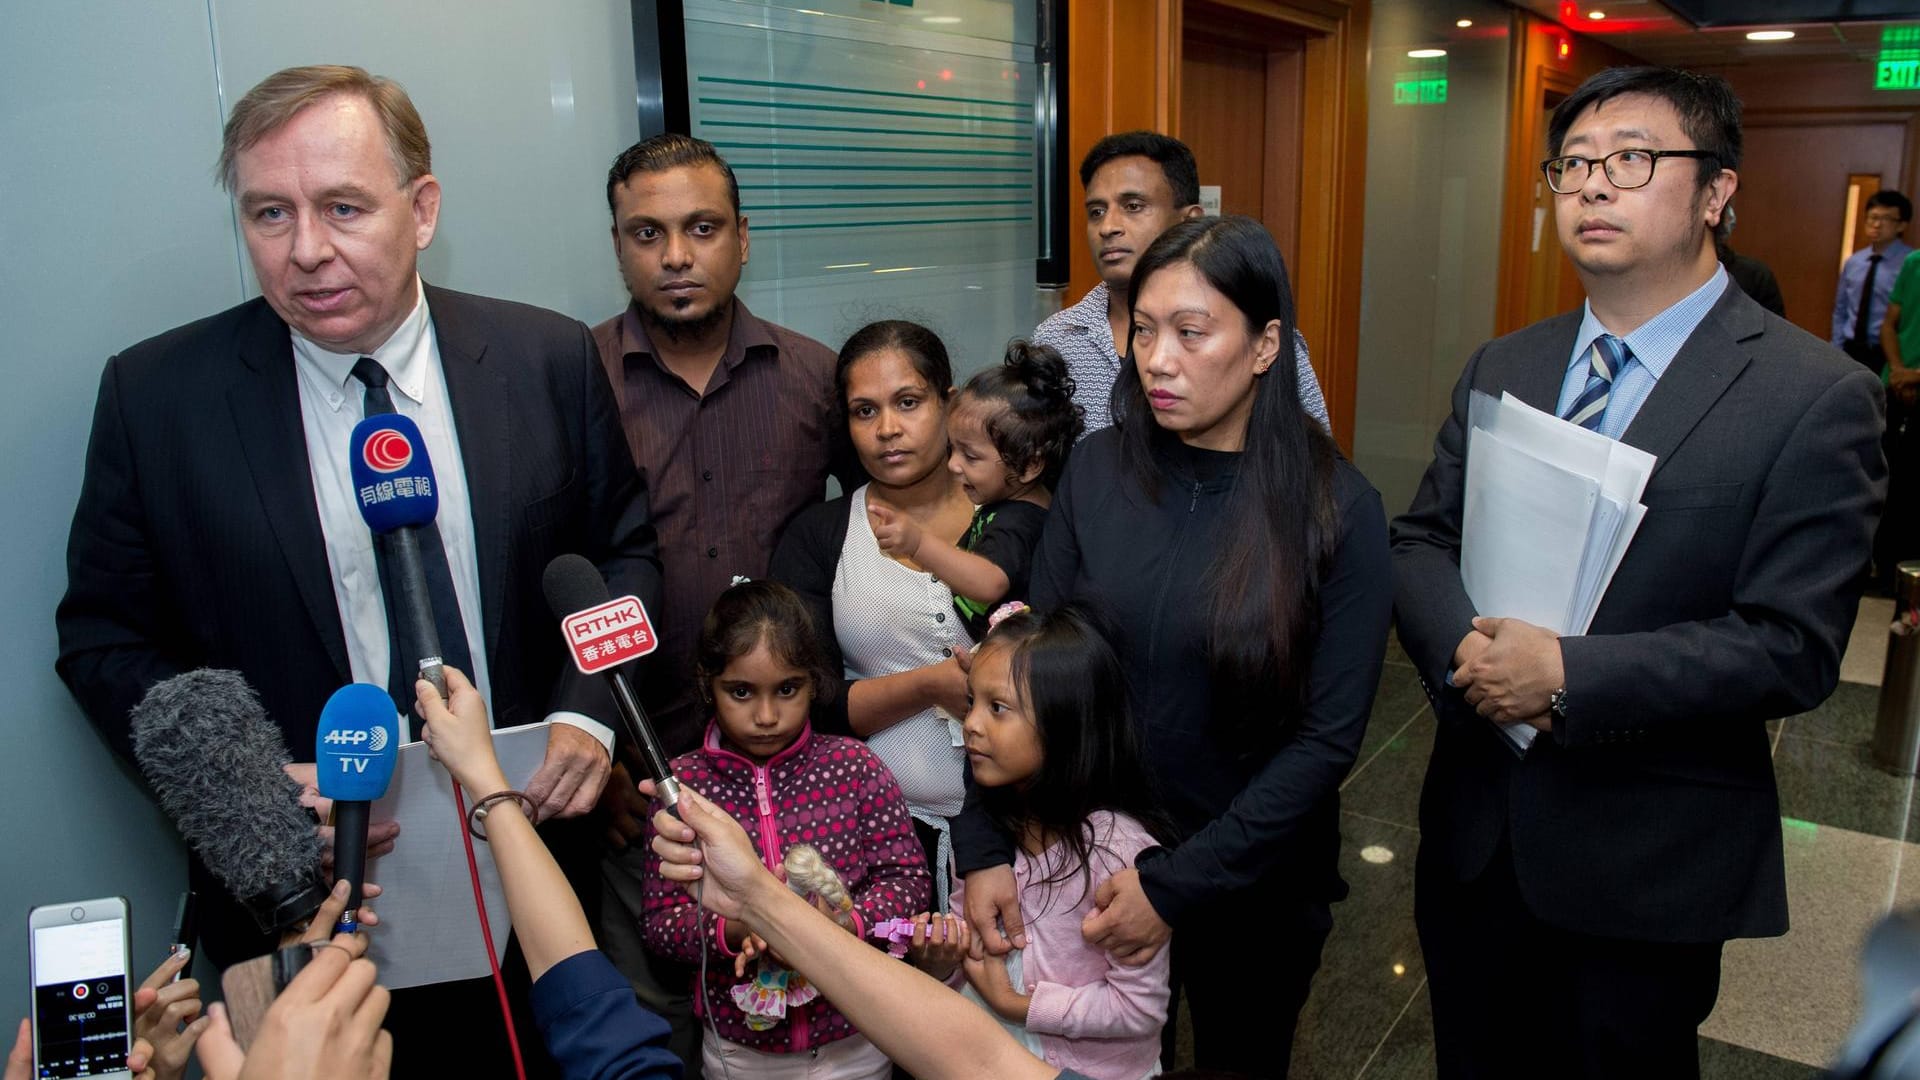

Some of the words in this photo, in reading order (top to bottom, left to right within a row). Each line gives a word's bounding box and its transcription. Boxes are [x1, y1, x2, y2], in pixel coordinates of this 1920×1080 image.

[360, 476, 432, 507] 有線電視
[573, 606, 637, 637] RTHK
[582, 630, 648, 662] 香港電台
[324, 729, 368, 745] AFP
[339, 757, 370, 773] TV
